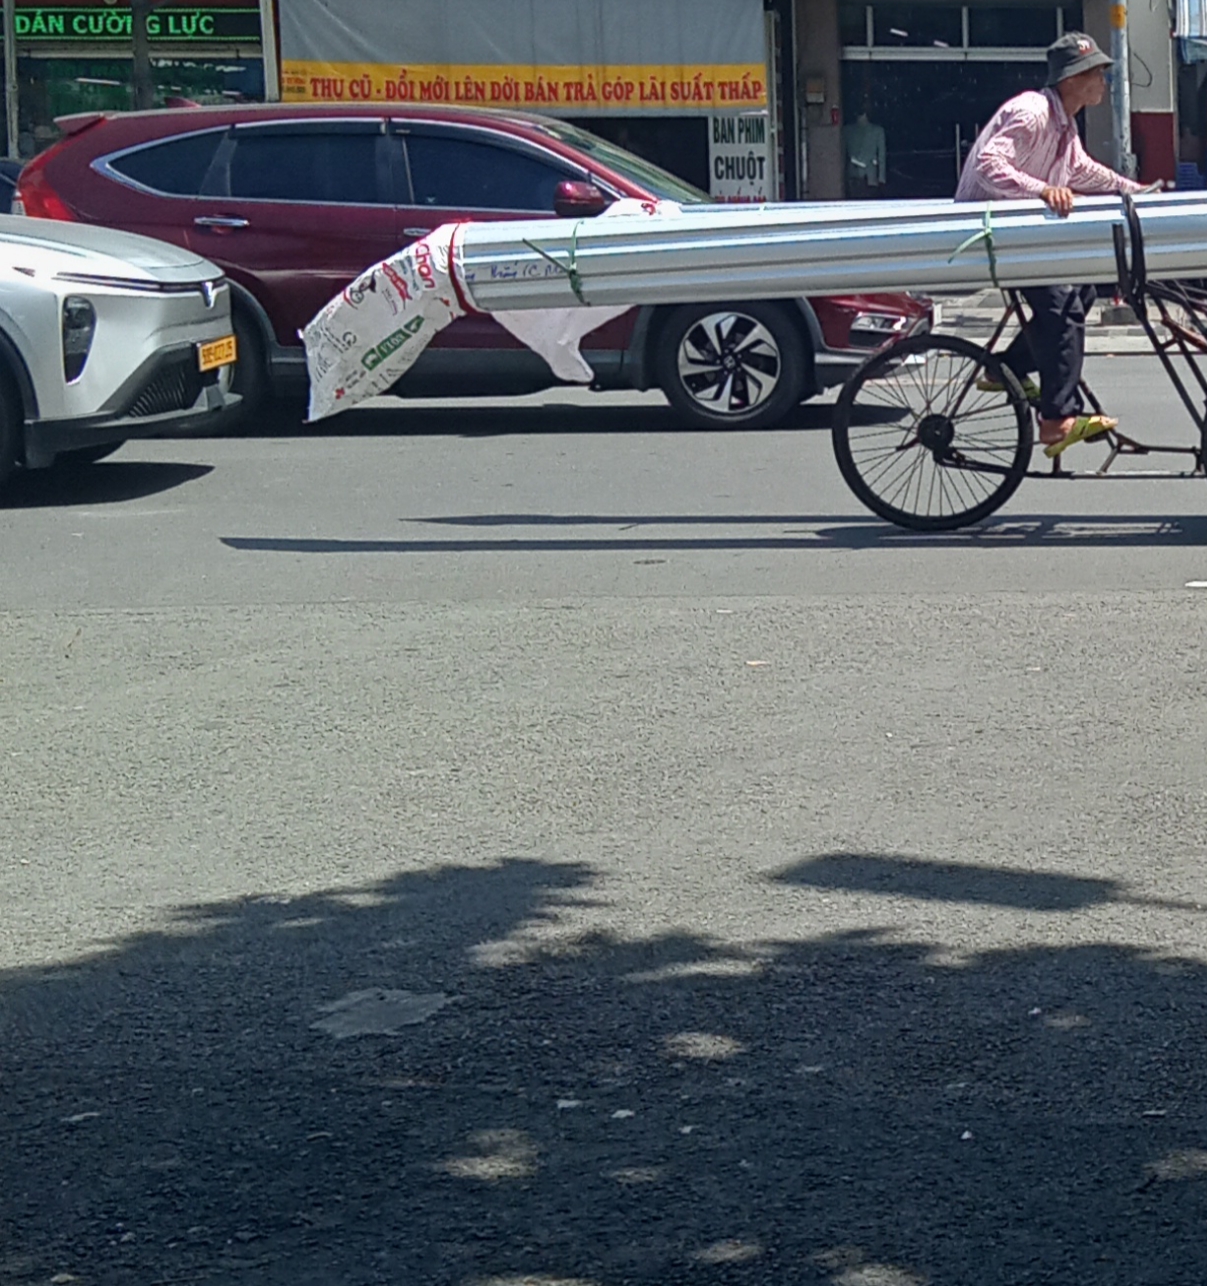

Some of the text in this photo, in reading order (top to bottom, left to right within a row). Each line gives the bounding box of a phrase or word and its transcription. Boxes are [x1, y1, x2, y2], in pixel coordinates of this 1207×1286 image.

[15, 11, 214, 37] DÁN CƯỜG LỰC
[311, 77, 344, 99] THU
[349, 74, 371, 98] CŨ
[385, 69, 415, 100] ĐỔI
[419, 75, 450, 102] MỚI
[454, 76, 486, 101] LÊN
[490, 75, 520, 101] ĐỜI
[524, 76, 559, 102] BÁN
[563, 74, 597, 101] TRẢ
[602, 76, 635, 102] GÓP
[639, 76, 666, 101] LÃI
[670, 72, 714, 101] SUẤT
[718, 71, 762, 100] THẤP
[714, 151, 765, 186] CHUỘT
